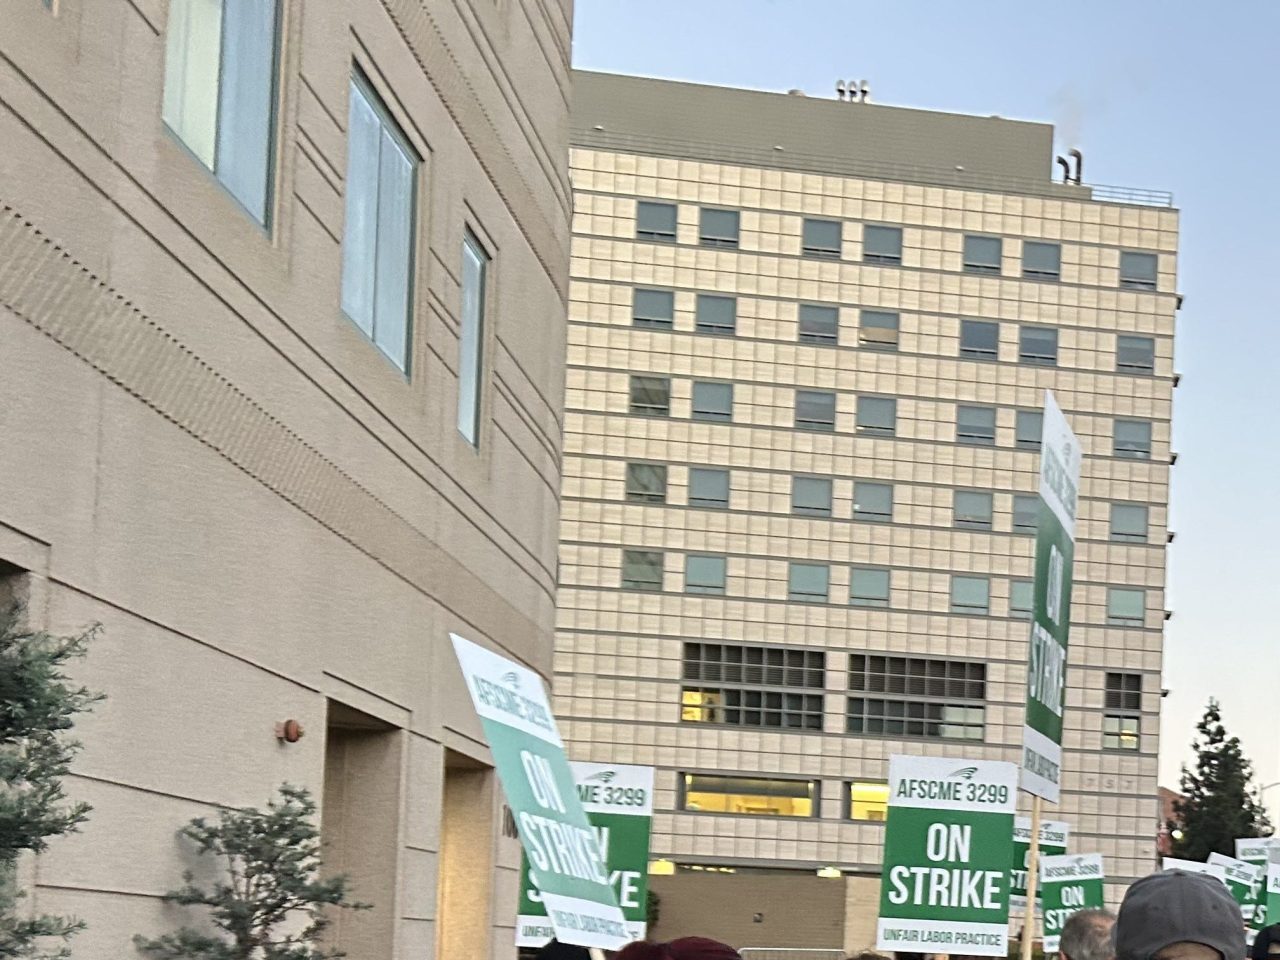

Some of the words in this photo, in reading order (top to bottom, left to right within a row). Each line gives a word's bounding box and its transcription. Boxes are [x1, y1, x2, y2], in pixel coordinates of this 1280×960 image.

[520, 750, 566, 814] ON
[603, 785, 646, 806] 3299
[897, 778, 962, 801] AFSCME
[966, 783, 1008, 804] 3299
[520, 811, 608, 885] STRIKE
[926, 823, 972, 863] ON
[888, 865, 1004, 909] STRIKE
[1061, 886, 1085, 906] ON
[883, 928, 918, 942] UNFAIR
[921, 931, 952, 944] LABOR
[954, 934, 1001, 946] PRACTICE
